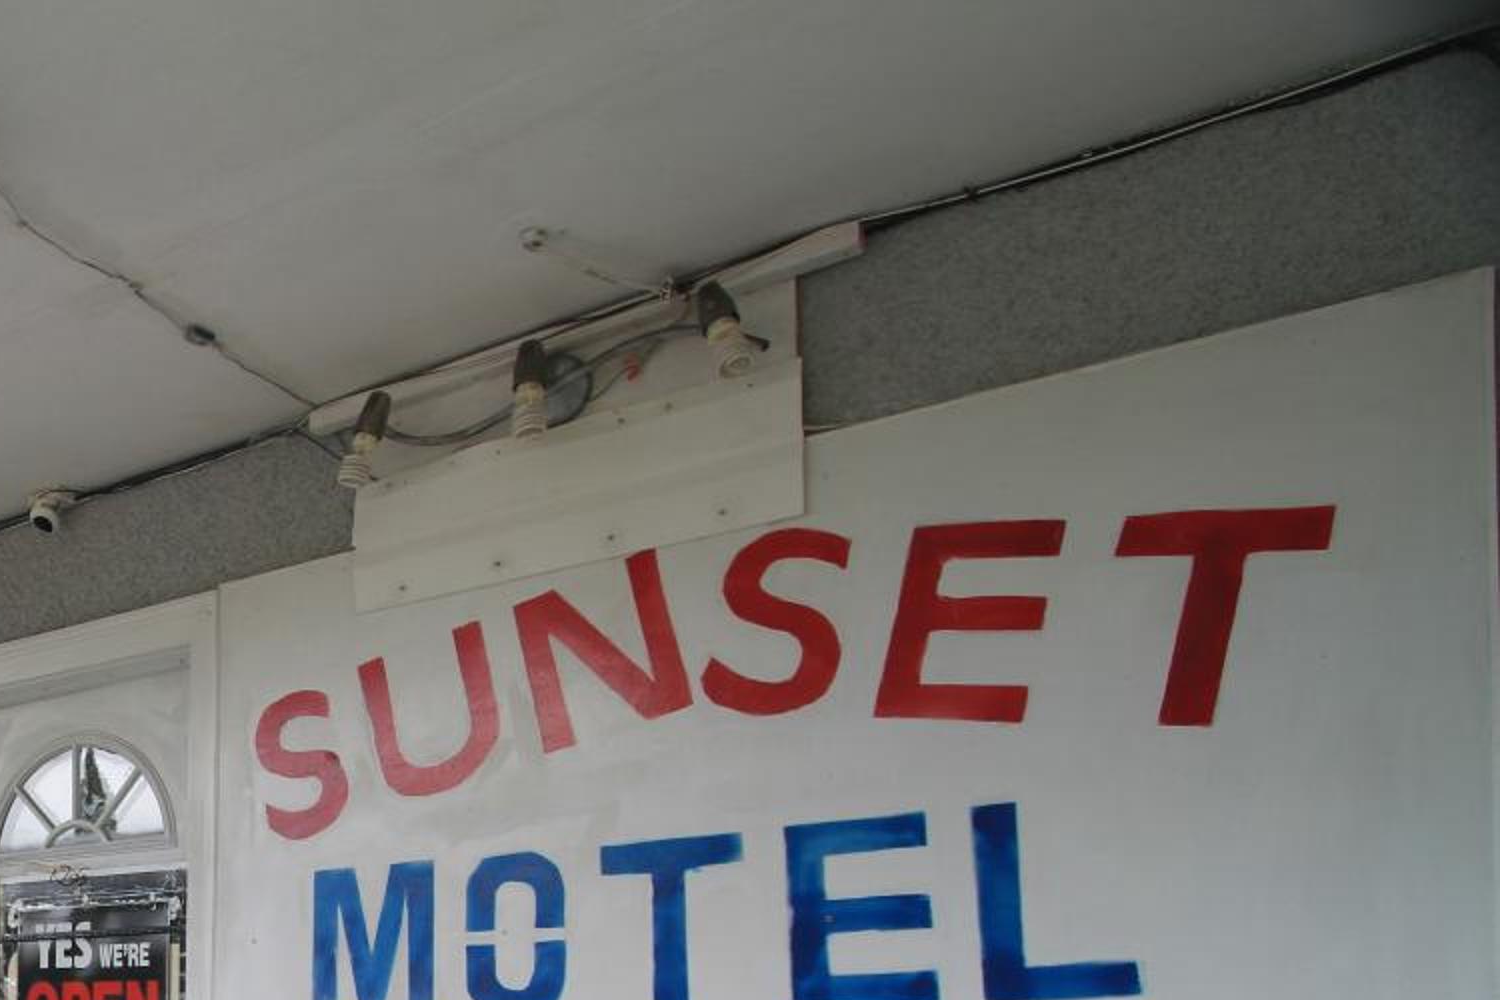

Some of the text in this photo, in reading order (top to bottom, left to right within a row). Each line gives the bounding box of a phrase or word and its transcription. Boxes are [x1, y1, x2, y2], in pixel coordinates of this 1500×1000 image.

[253, 505, 1336, 840] SUNSET
[36, 922, 150, 968] YES WE'RE
